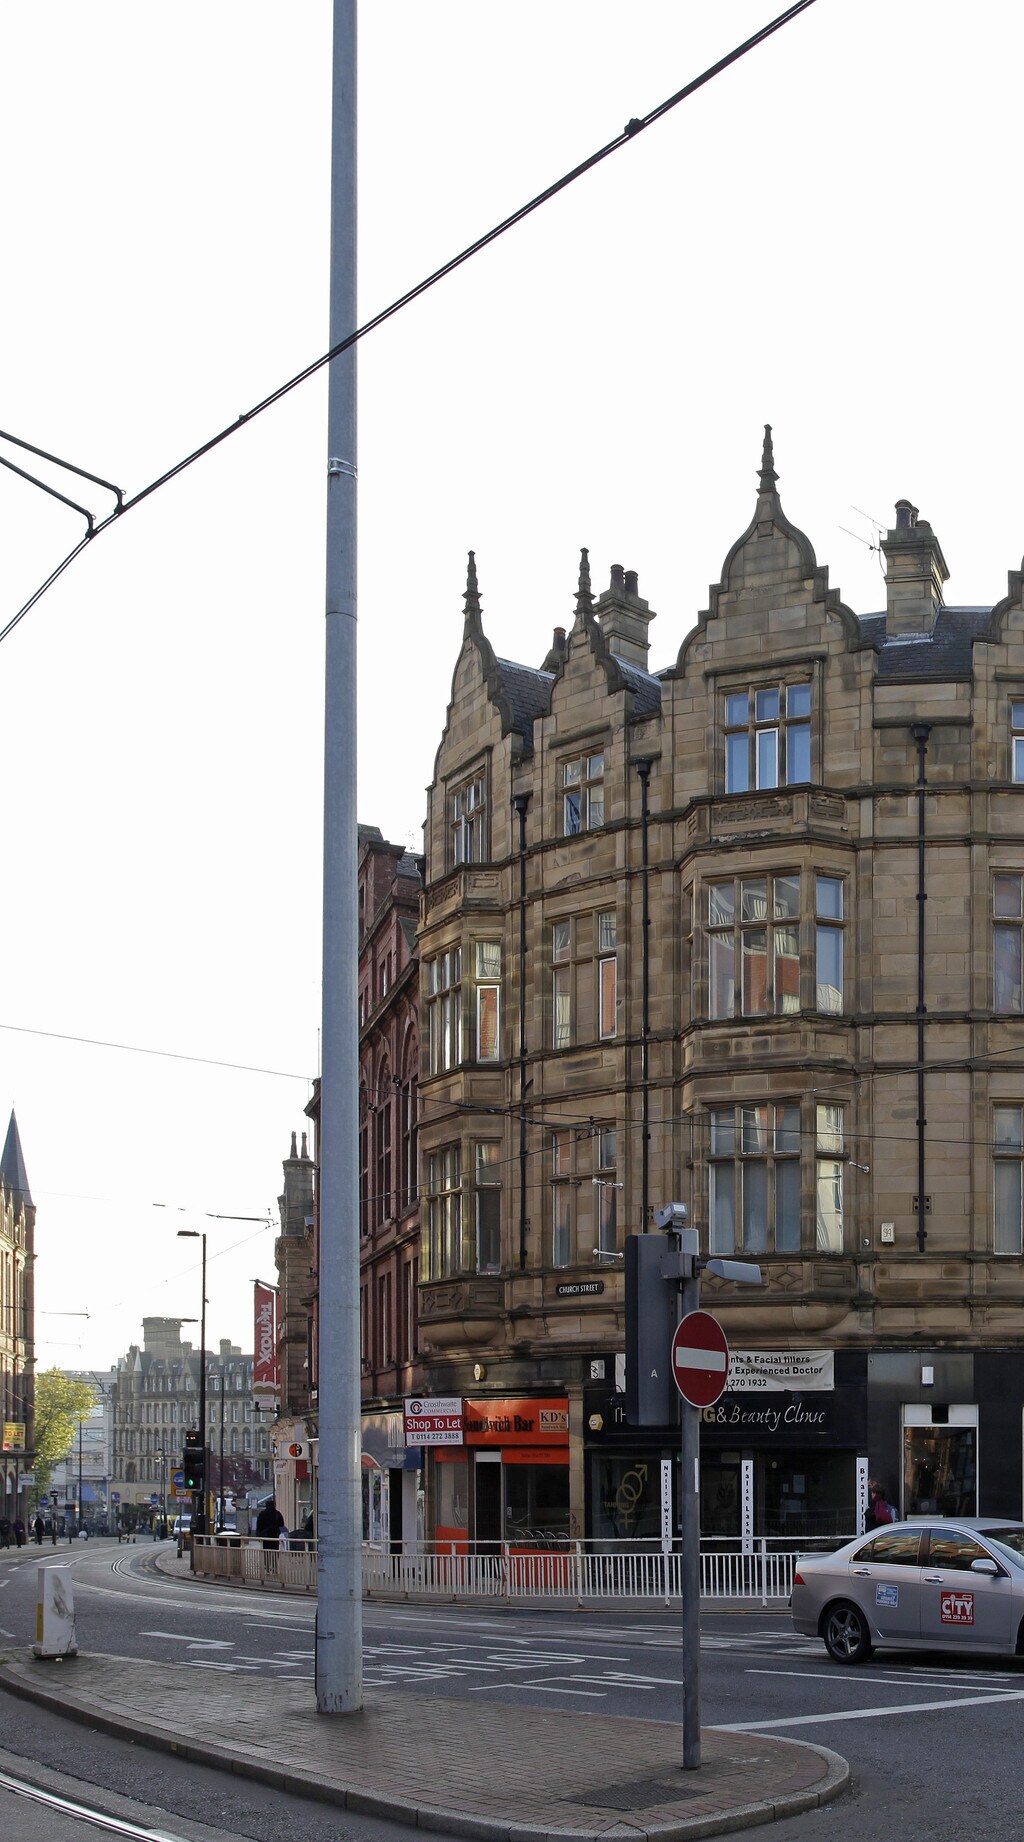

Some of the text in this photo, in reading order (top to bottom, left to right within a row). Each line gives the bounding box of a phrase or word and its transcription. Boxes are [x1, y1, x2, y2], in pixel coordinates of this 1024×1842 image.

[559, 1283, 598, 1294] CHURCH STREET
[746, 1355, 752, 1364] &
[754, 1355, 782, 1364] Facial
[783, 1355, 810, 1363] fillers
[650, 1369, 658, 1378] A
[735, 1366, 790, 1377] Experienced
[792, 1366, 823, 1375] Doctor
[731, 1379, 746, 1387] 270
[748, 1379, 767, 1387] 1932
[513, 1412, 535, 1432] Bar
[540, 1412, 566, 1422] KD's
[729, 1407, 781, 1431] Beauty
[784, 1402, 825, 1424] Clinic
[406, 1418, 461, 1432] Shop To Let
